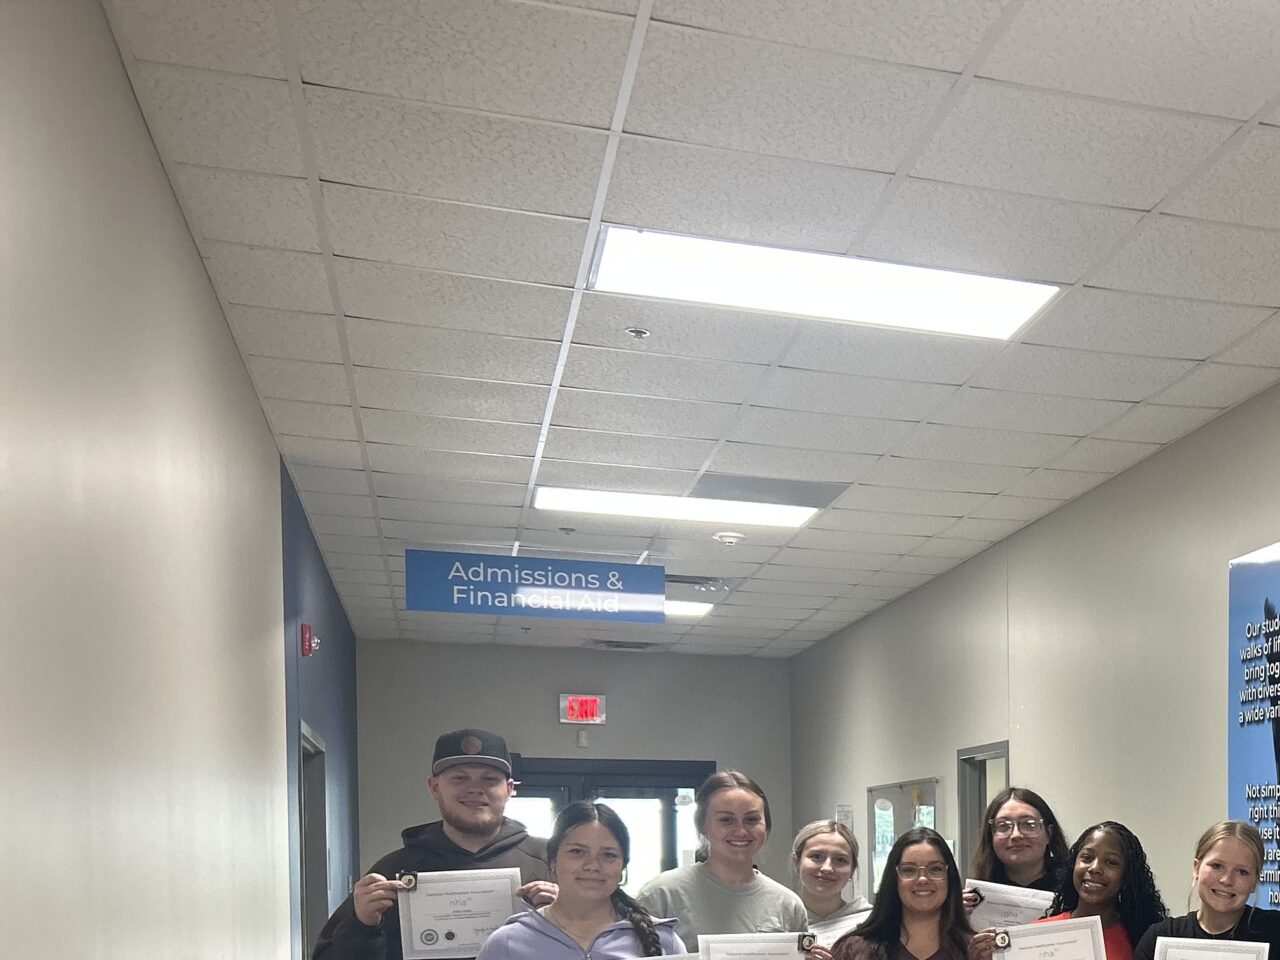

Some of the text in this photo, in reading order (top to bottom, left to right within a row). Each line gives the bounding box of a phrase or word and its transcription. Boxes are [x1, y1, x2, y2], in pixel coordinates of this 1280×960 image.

[448, 561, 624, 590] Admissions &
[453, 586, 618, 612] Financial Aid
[1246, 622, 1261, 638] Our
[1240, 643, 1262, 660] walks
[1264, 639, 1271, 655] of
[1244, 664, 1264, 681] bring
[1240, 683, 1257, 702] with
[568, 696, 600, 720] EXIT
[1239, 712, 1244, 723] a
[1245, 705, 1264, 722] wide
[1246, 784, 1260, 798] Not
[1248, 804, 1268, 822] right
[1274, 824, 1280, 839] it
[1268, 851, 1280, 860] are
[1039, 949, 1055, 958] nha
